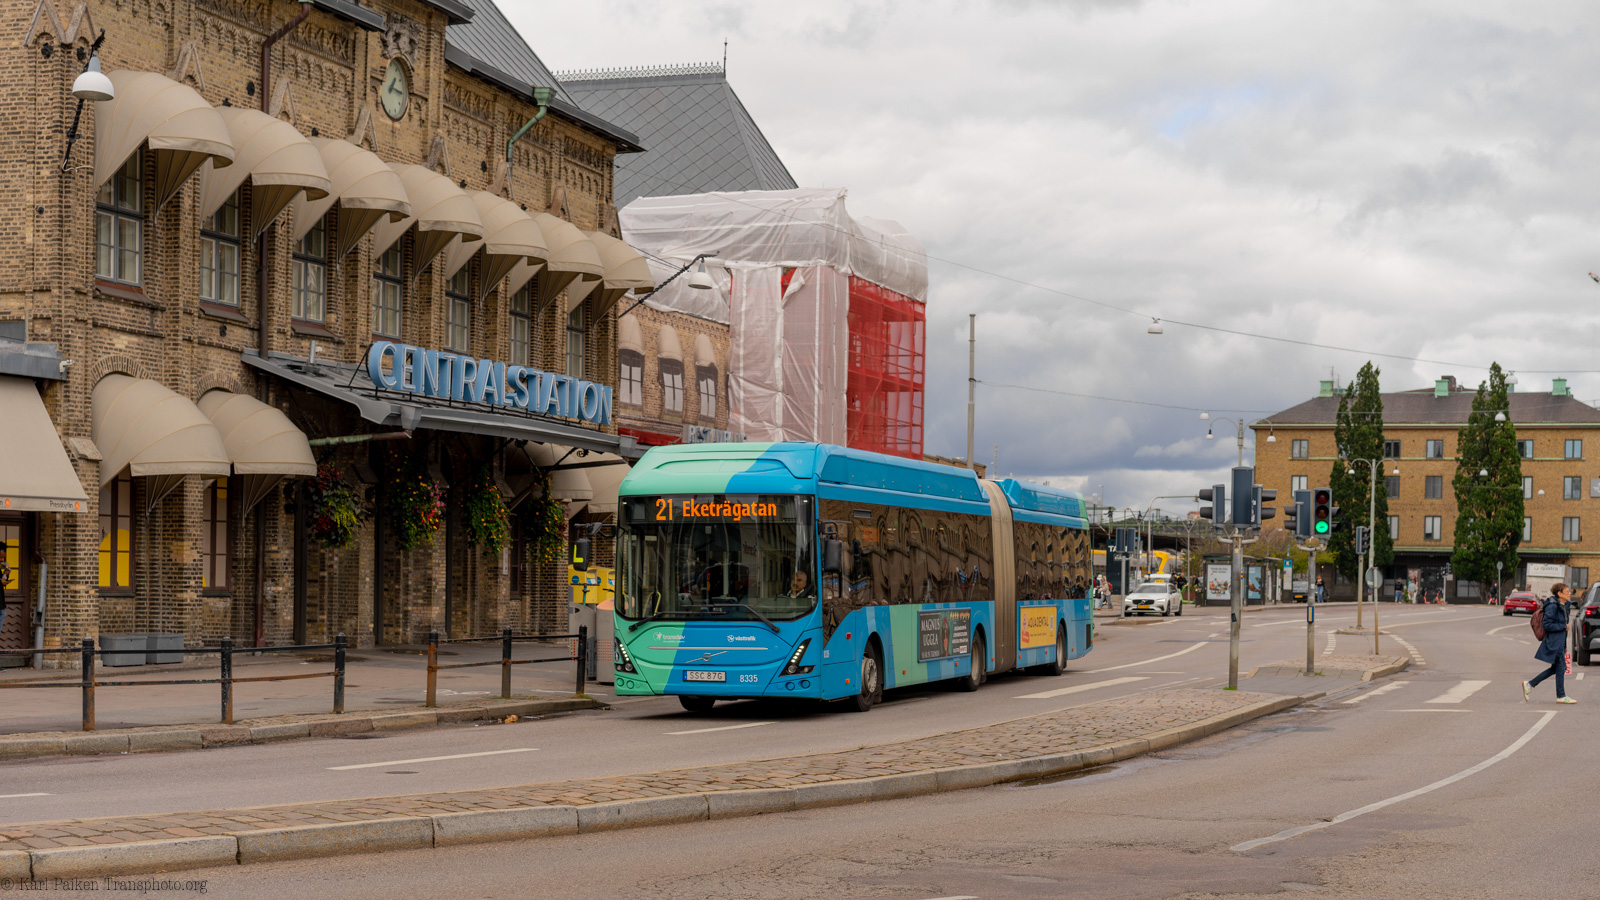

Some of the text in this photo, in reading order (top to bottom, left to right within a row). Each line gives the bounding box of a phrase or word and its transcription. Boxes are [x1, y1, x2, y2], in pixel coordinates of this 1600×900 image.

[368, 341, 613, 425] CENTRALSTATION
[656, 498, 777, 521] 21 Eketrägatan
[690, 671, 722, 680] SSC 87G
[740, 674, 758, 683] 8335
